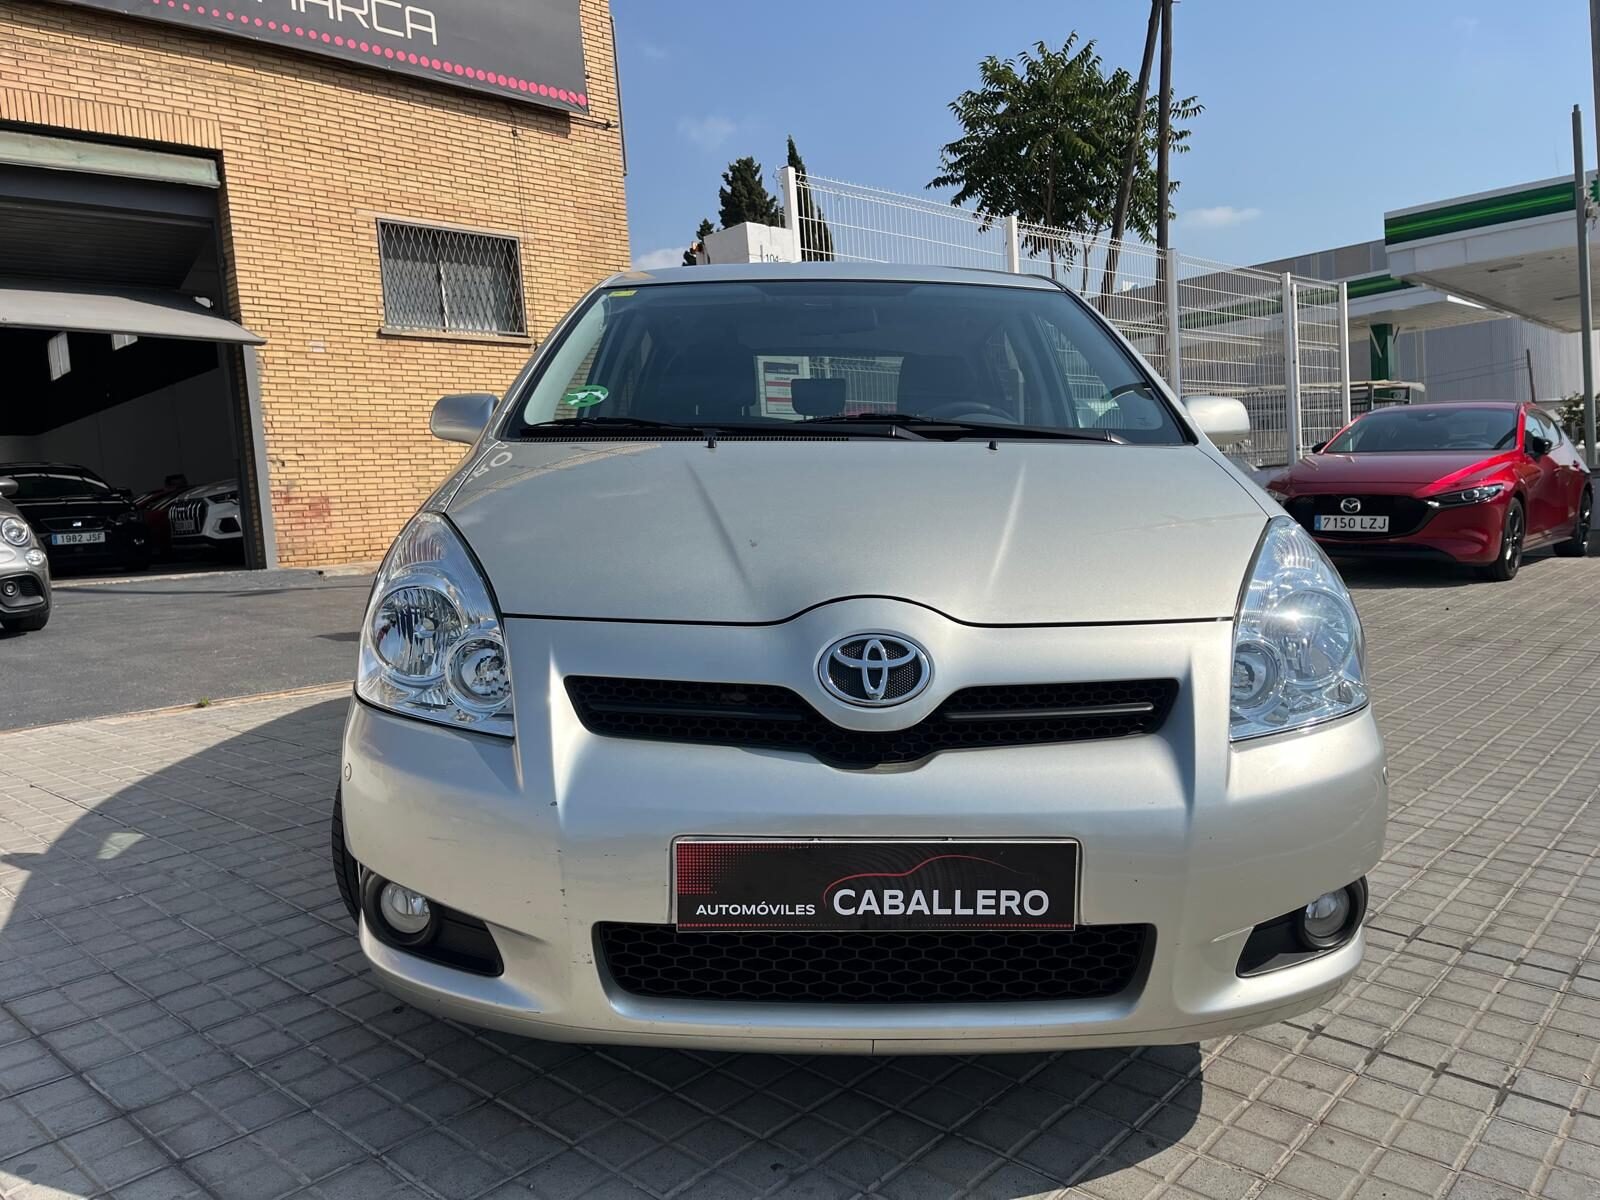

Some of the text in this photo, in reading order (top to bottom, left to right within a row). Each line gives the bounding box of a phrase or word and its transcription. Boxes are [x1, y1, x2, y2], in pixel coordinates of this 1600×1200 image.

[257, 0, 438, 46] ARCA
[1323, 517, 1387, 529] 7150 LZJ
[60, 534, 83, 543] 1982
[696, 889, 1050, 916] AUTOMÓVILES CABALLERO
